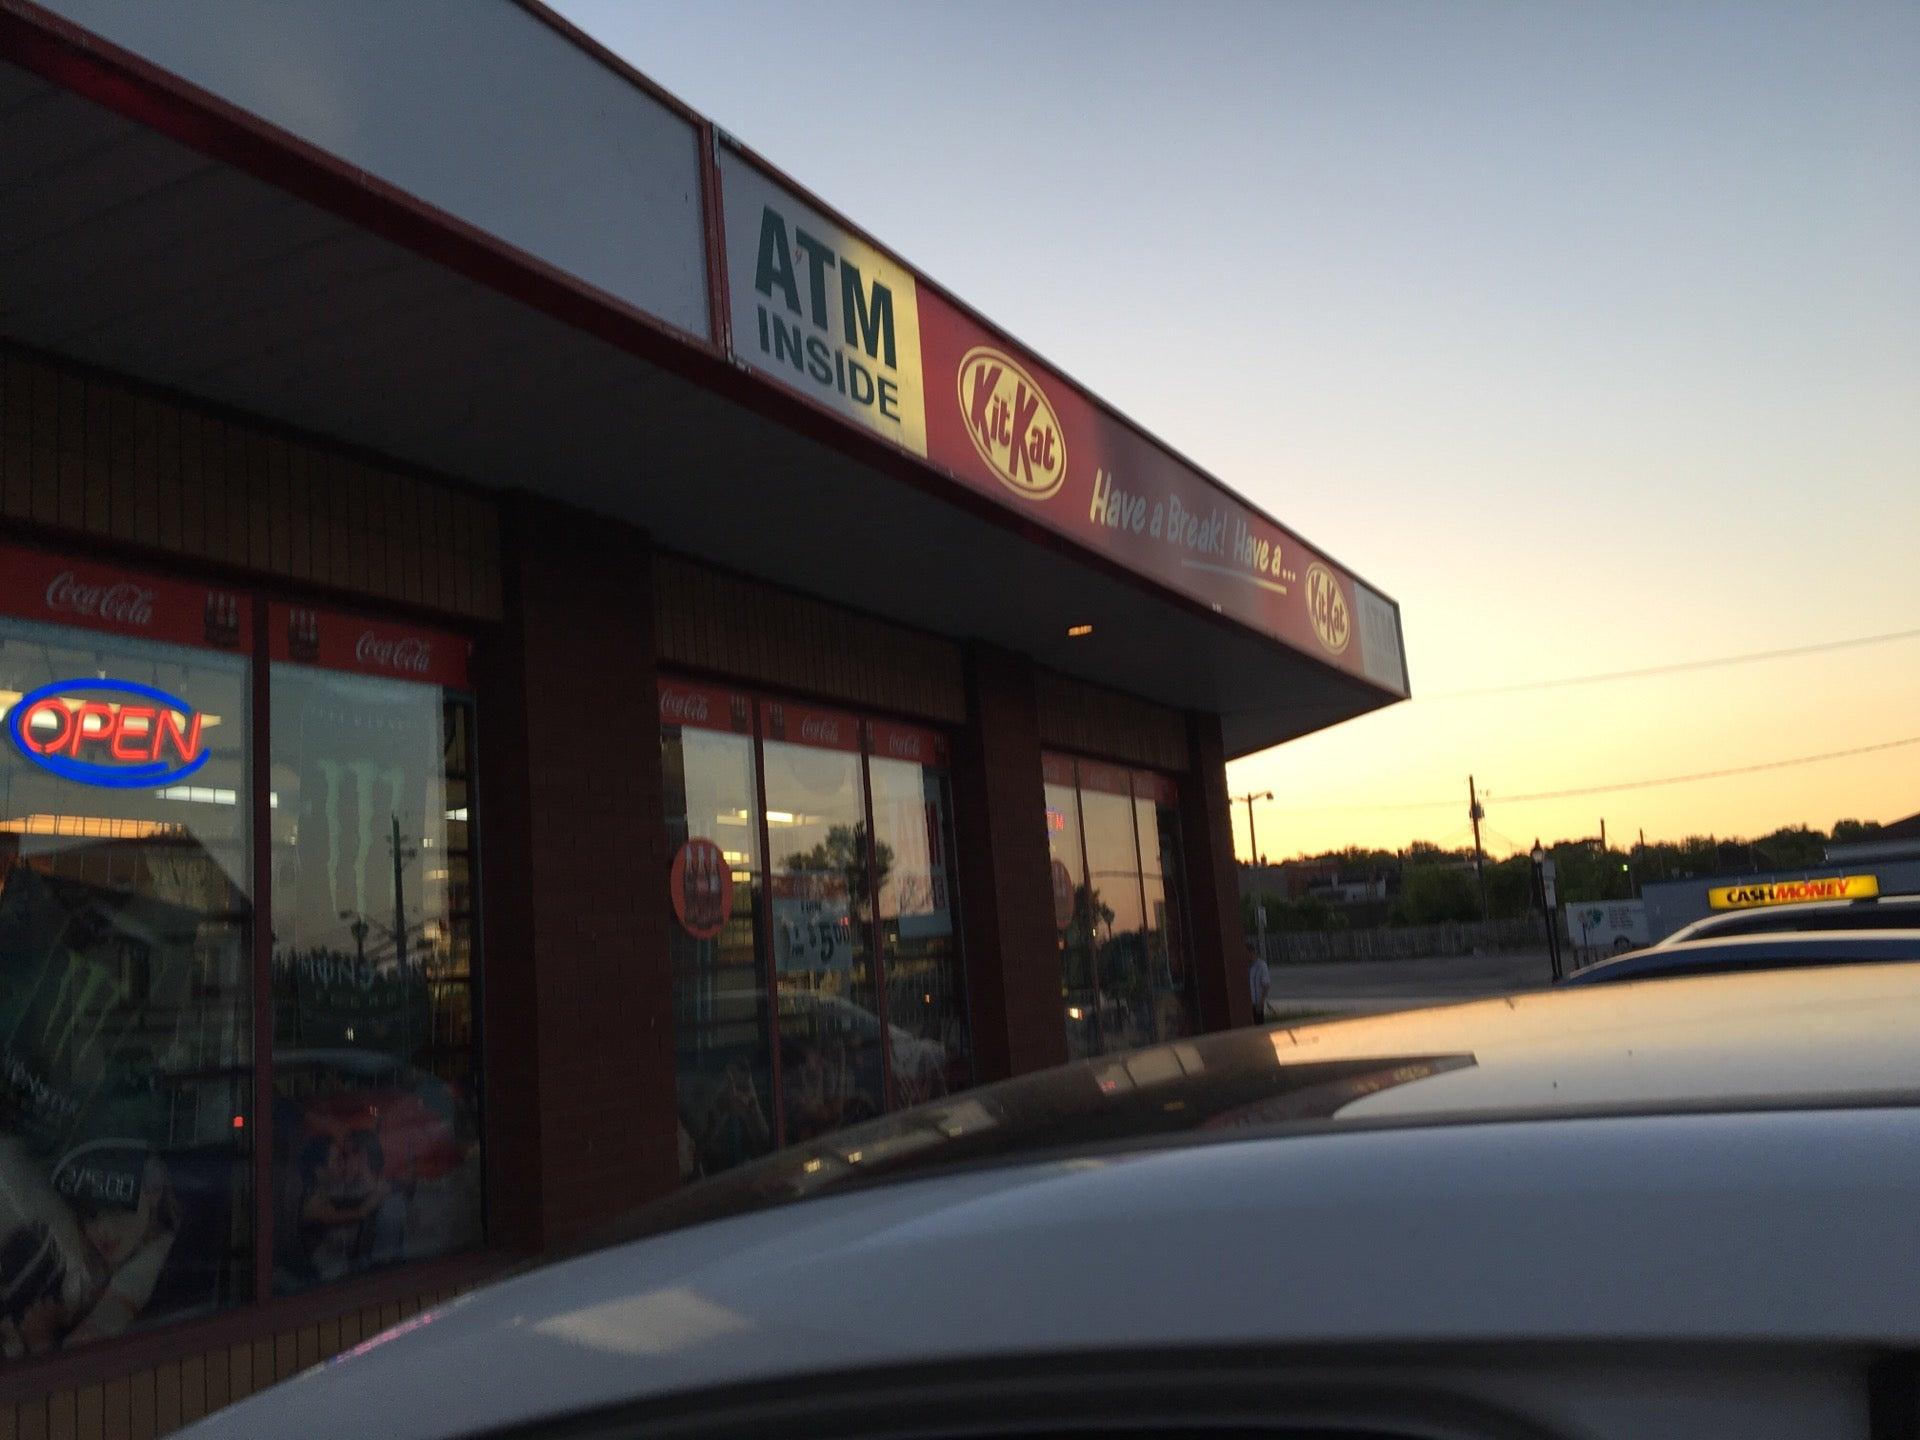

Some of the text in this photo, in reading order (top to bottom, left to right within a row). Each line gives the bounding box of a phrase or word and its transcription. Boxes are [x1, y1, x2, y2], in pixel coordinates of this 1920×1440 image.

[755, 204, 898, 371] ATM
[757, 303, 901, 423] INSIDE
[1089, 467, 1147, 534] Have
[1150, 501, 1165, 538] a
[1167, 494, 1228, 557] Break!
[1233, 518, 1271, 572] Have
[21, 697, 202, 763] OPEN
